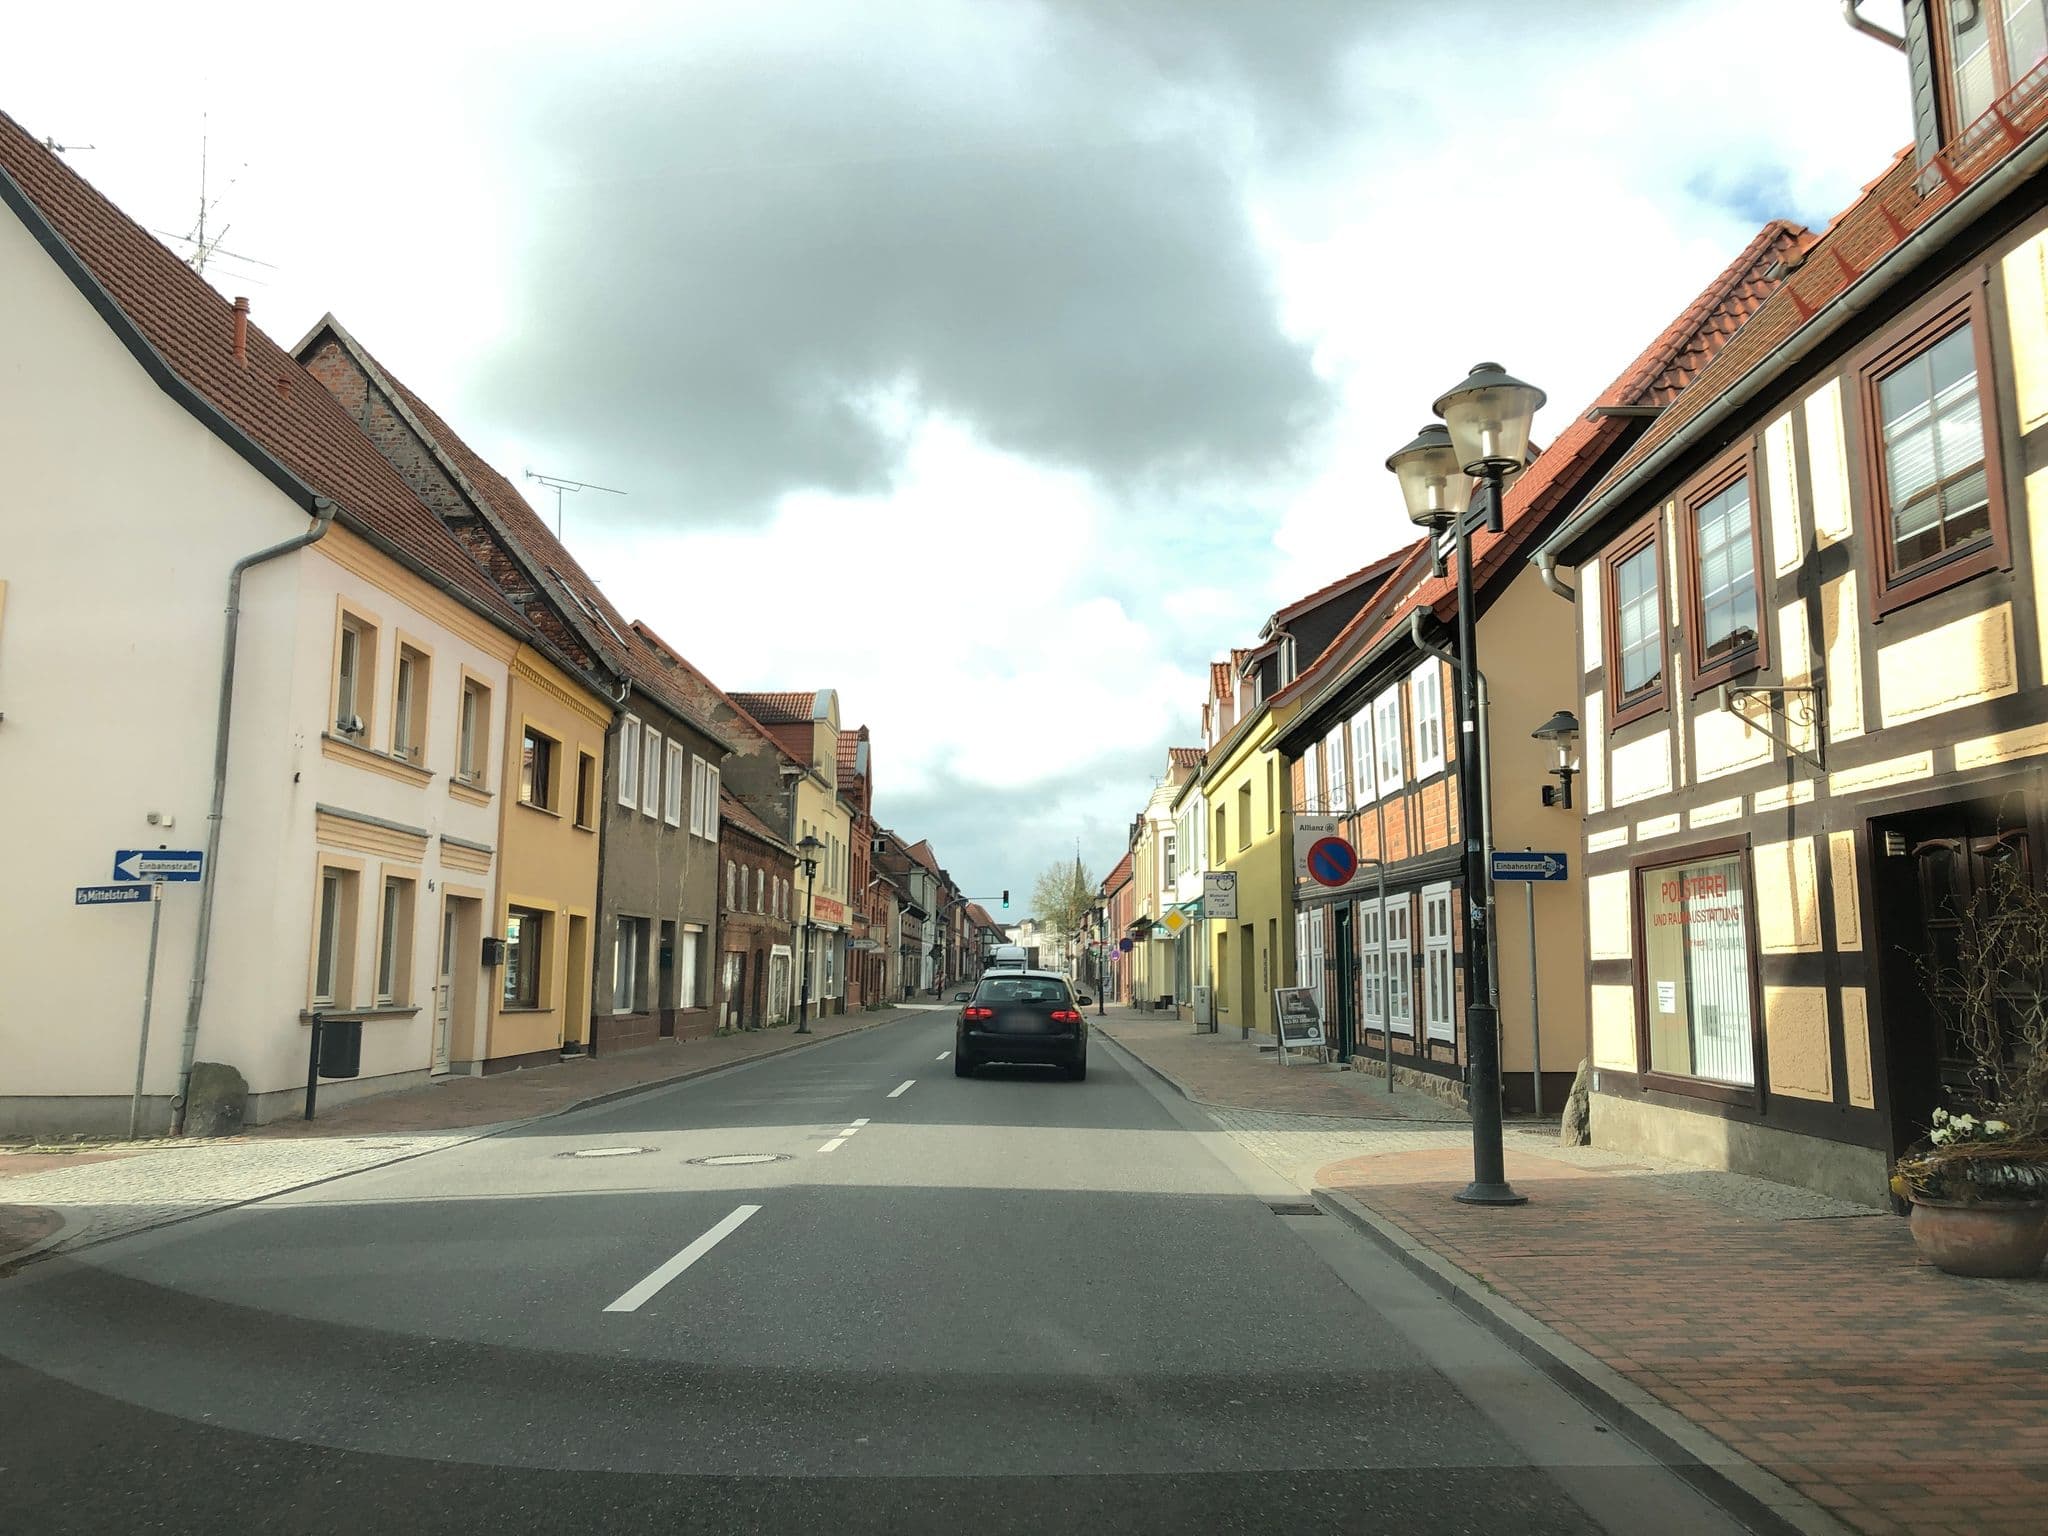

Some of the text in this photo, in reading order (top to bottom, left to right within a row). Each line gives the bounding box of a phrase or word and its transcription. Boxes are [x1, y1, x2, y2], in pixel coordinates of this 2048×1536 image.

[1299, 823, 1324, 831] Allianz
[138, 862, 198, 871] Einbahnstraße
[1495, 862, 1547, 870] Einbahnstraße
[87, 888, 140, 901] Mittelstraße
[1661, 875, 1727, 904] POLSTEREI
[1653, 906, 1740, 927] UND RAUMAUSSTATTUNG
